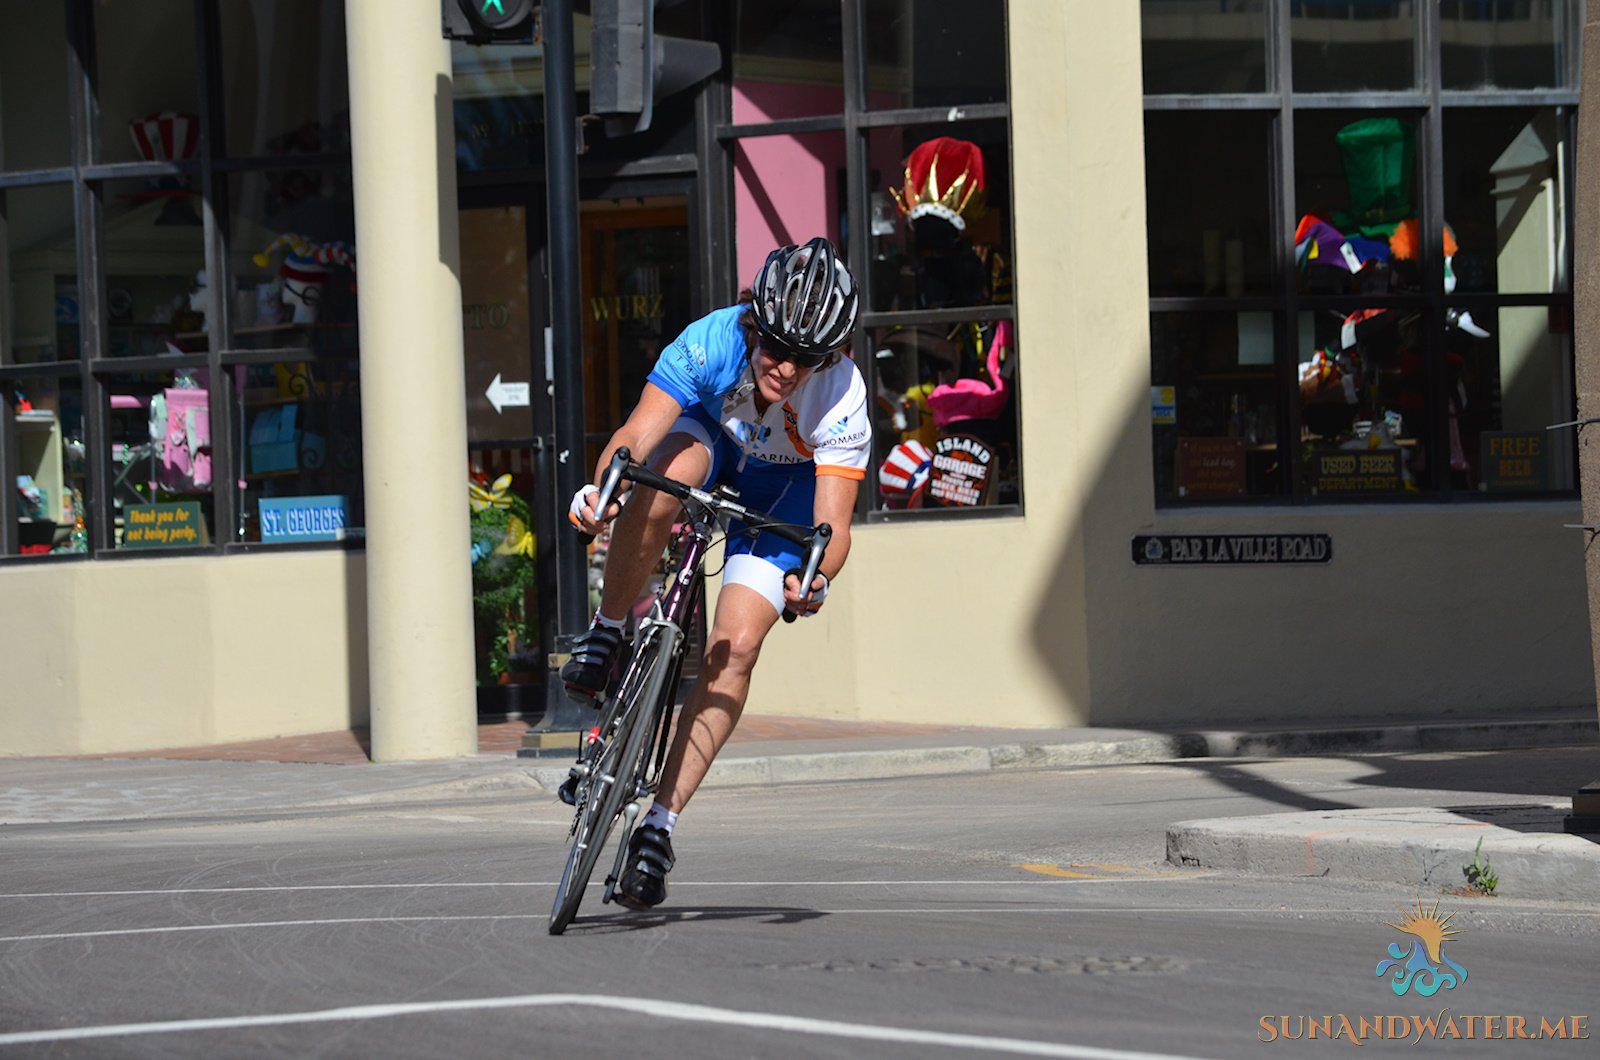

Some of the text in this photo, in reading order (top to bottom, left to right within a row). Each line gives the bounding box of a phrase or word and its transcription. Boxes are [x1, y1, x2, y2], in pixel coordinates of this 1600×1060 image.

[590, 293, 665, 321] WURZ
[936, 437, 991, 463] ISLAND
[1489, 437, 1541, 457] FREE
[932, 455, 987, 479] GARAGE
[1320, 453, 1395, 474] USED BEER
[1498, 459, 1532, 477] BEER
[1318, 476, 1399, 490] DEPARTMENT
[130, 507, 190, 526] Thank you for
[262, 506, 345, 536] ST. GEORGES
[127, 528, 143, 541] not
[144, 526, 169, 544] being
[1169, 537, 1203, 562] PAR
[1280, 536, 1328, 562] ROAD
